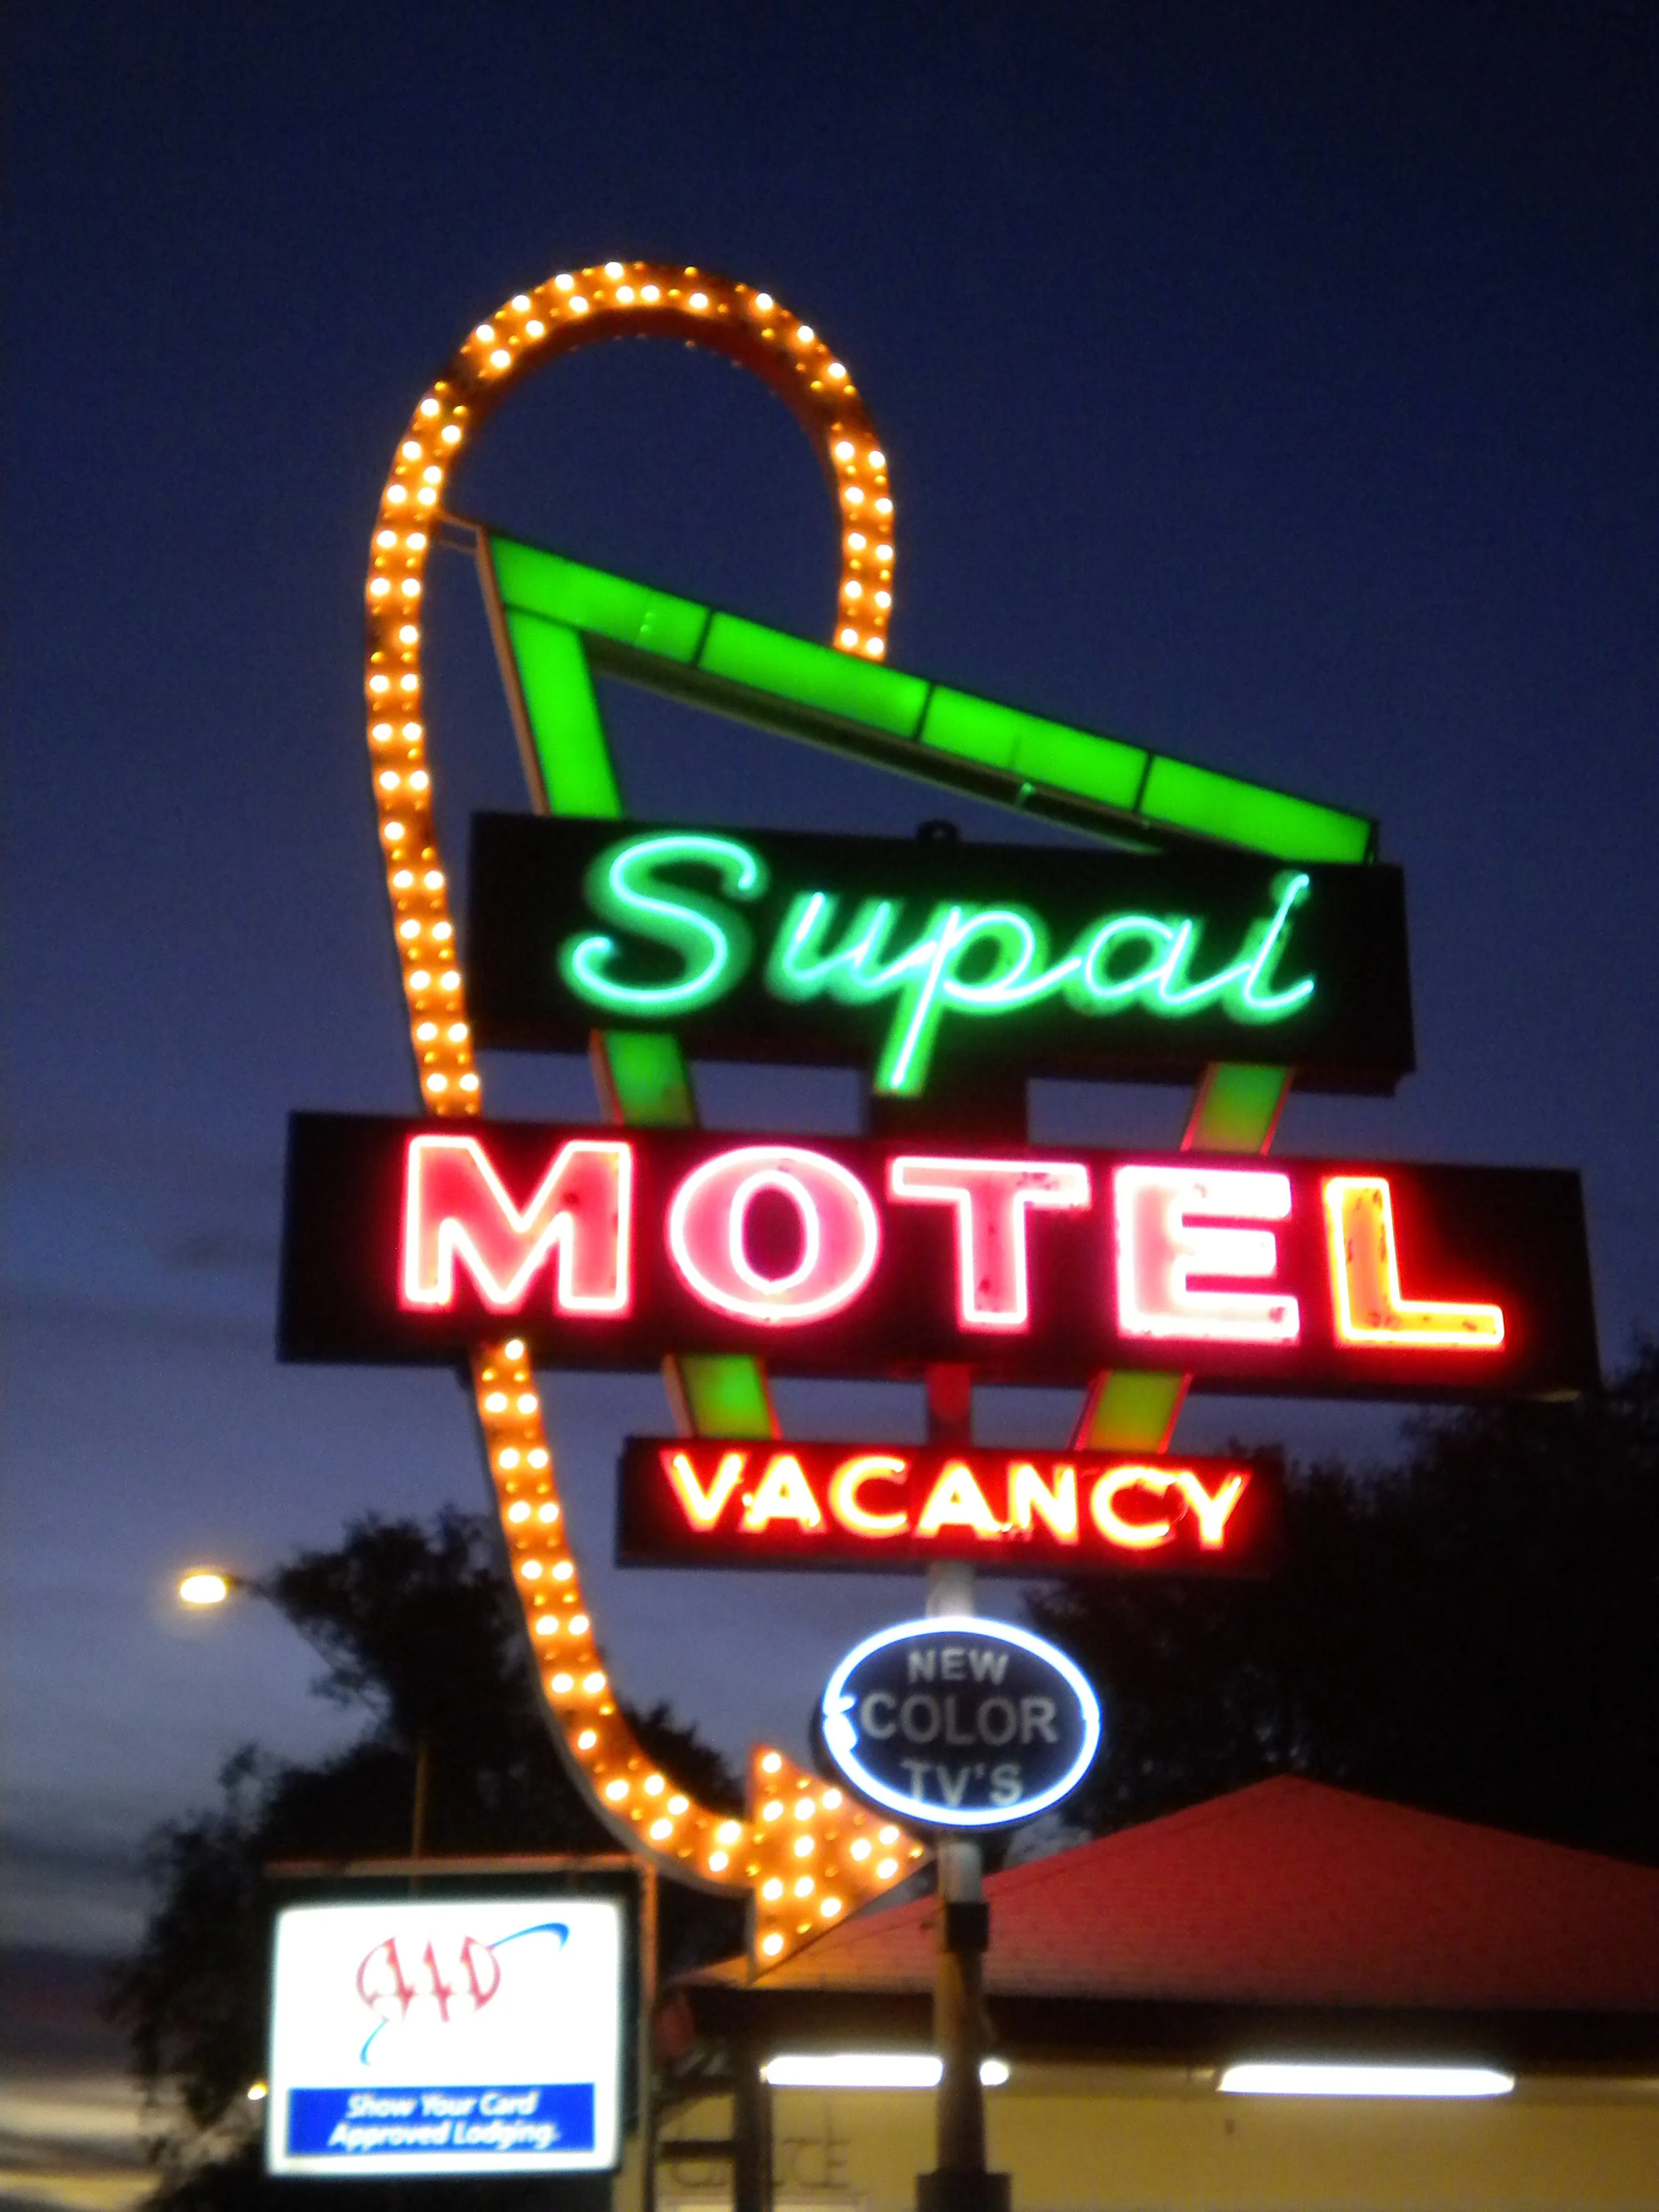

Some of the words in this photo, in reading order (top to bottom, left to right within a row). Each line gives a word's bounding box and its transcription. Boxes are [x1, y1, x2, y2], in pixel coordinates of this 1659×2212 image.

[564, 835, 1315, 1096] Supai
[399, 1132, 1508, 1354] MOTEL
[661, 1449, 1250, 1552] VACANCY
[906, 1647, 1010, 1686] NEW
[860, 1691, 1059, 1747] COLOR
[900, 1757, 1024, 1807] TV'S
[345, 2092, 417, 2119] Show
[421, 2093, 476, 2117] Your
[479, 2089, 540, 2116] Card
[328, 2119, 451, 2153] Approved
